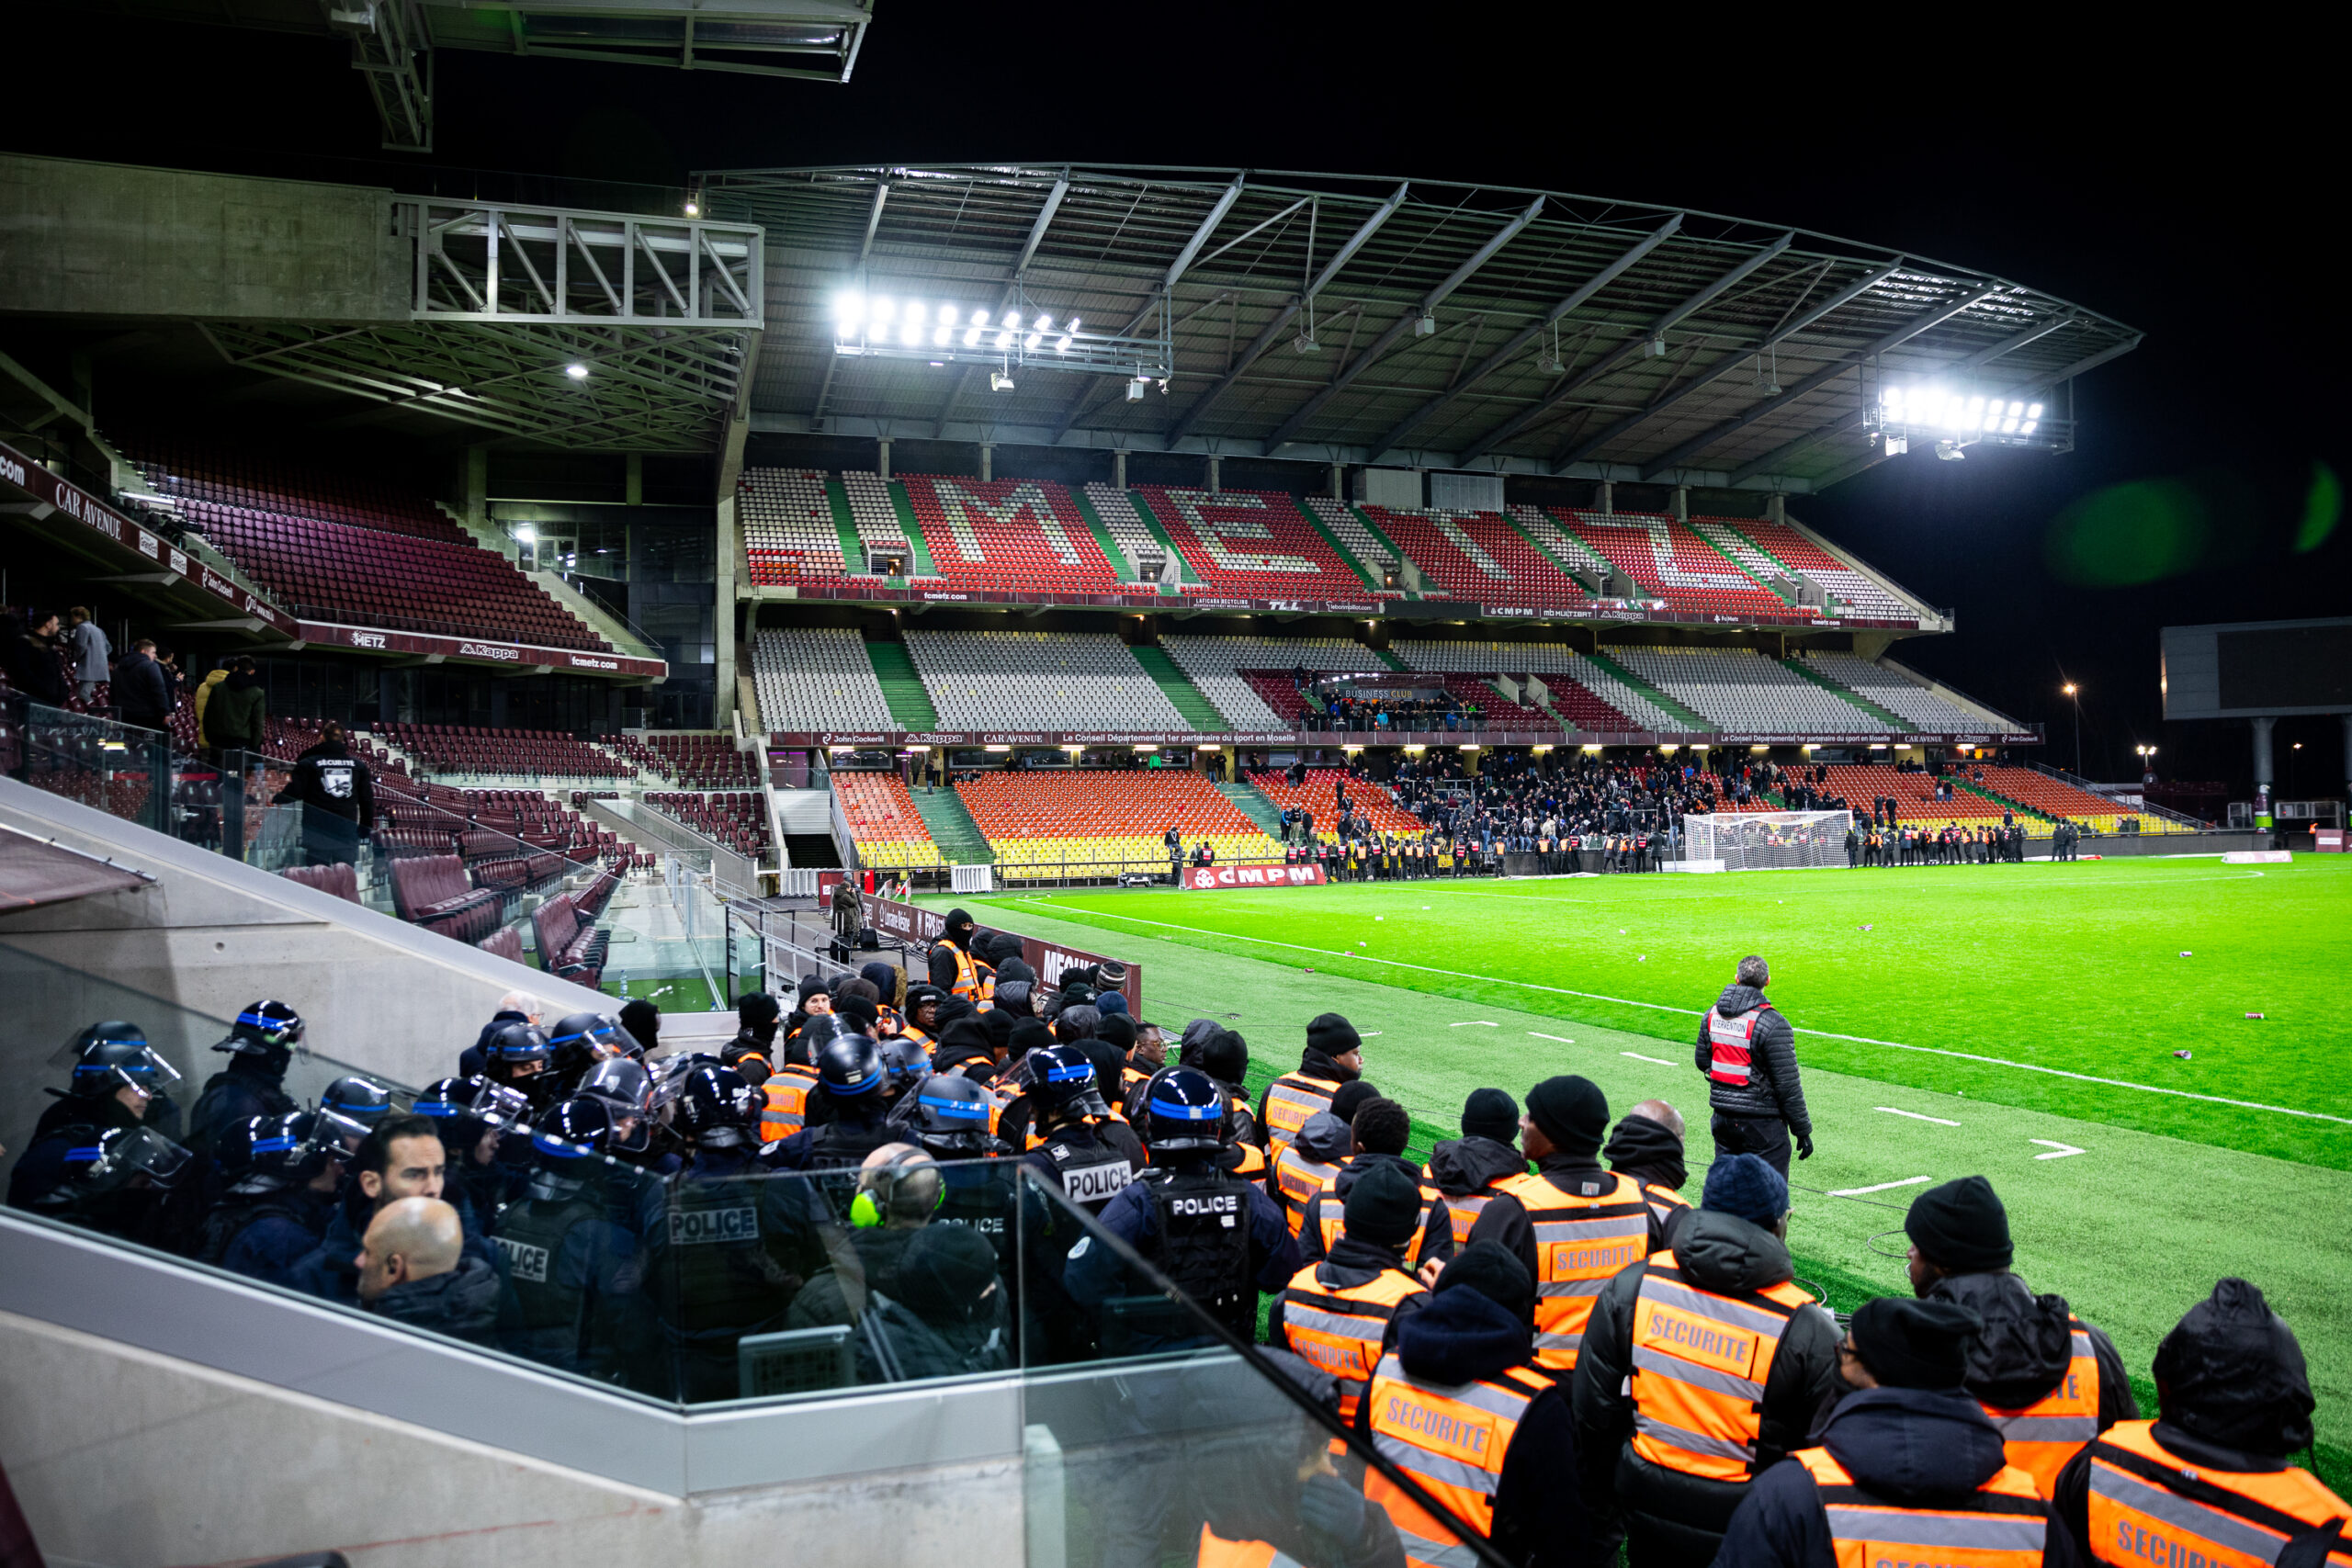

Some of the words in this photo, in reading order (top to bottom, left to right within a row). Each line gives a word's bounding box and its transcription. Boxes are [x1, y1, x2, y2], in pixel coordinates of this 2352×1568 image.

[55, 482, 81, 519] CAR
[83, 499, 122, 541] AVENUE
[932, 479, 1758, 590] METZ
[923, 592, 967, 600] fcmetz.com
[1497, 607, 1533, 615] CMPM
[1555, 610, 1592, 618] MULTIBAT
[1611, 610, 1645, 621] Kappa
[353, 636, 386, 649] METZ
[476, 645, 519, 660] Kappa
[571, 656, 618, 670] fcmetz.com
[1345, 690, 1389, 698] BUSINESS
[1390, 690, 1412, 698] CLUB
[833, 735, 853, 743] John
[853, 735, 885, 743] Cockerill
[920, 734, 963, 745] Kappa
[983, 734, 1006, 743] CAR
[1006, 734, 1043, 743] AVENUE
[1062, 733, 1073, 742] Le
[1075, 733, 1105, 742] Conseil
[1107, 733, 1165, 744] Départemental
[1167, 734, 1179, 742] 1er
[1181, 734, 1220, 744] partenaire
[1221, 734, 1232, 742] du
[1234, 735, 1254, 744] sport
[1266, 734, 1296, 742] Moselle
[1796, 735, 1806, 743] 1er
[1806, 735, 1836, 744] partenaire
[1870, 735, 1891, 743] Moselle
[1962, 734, 1990, 743] Kappa
[1218, 866, 1316, 885] CMPM
[1711, 1019, 1747, 1033] INTERVENTION
[1069, 1165, 1129, 1198] POLICE
[1172, 1195, 1238, 1215] POLICE
[671, 1209, 756, 1237] POLICE
[1557, 1246, 1634, 1270] SECURITE
[1651, 1314, 1748, 1363] SECURITE
[1294, 1337, 1363, 1371] SECURITE
[1387, 1397, 1487, 1453] SECURITE
